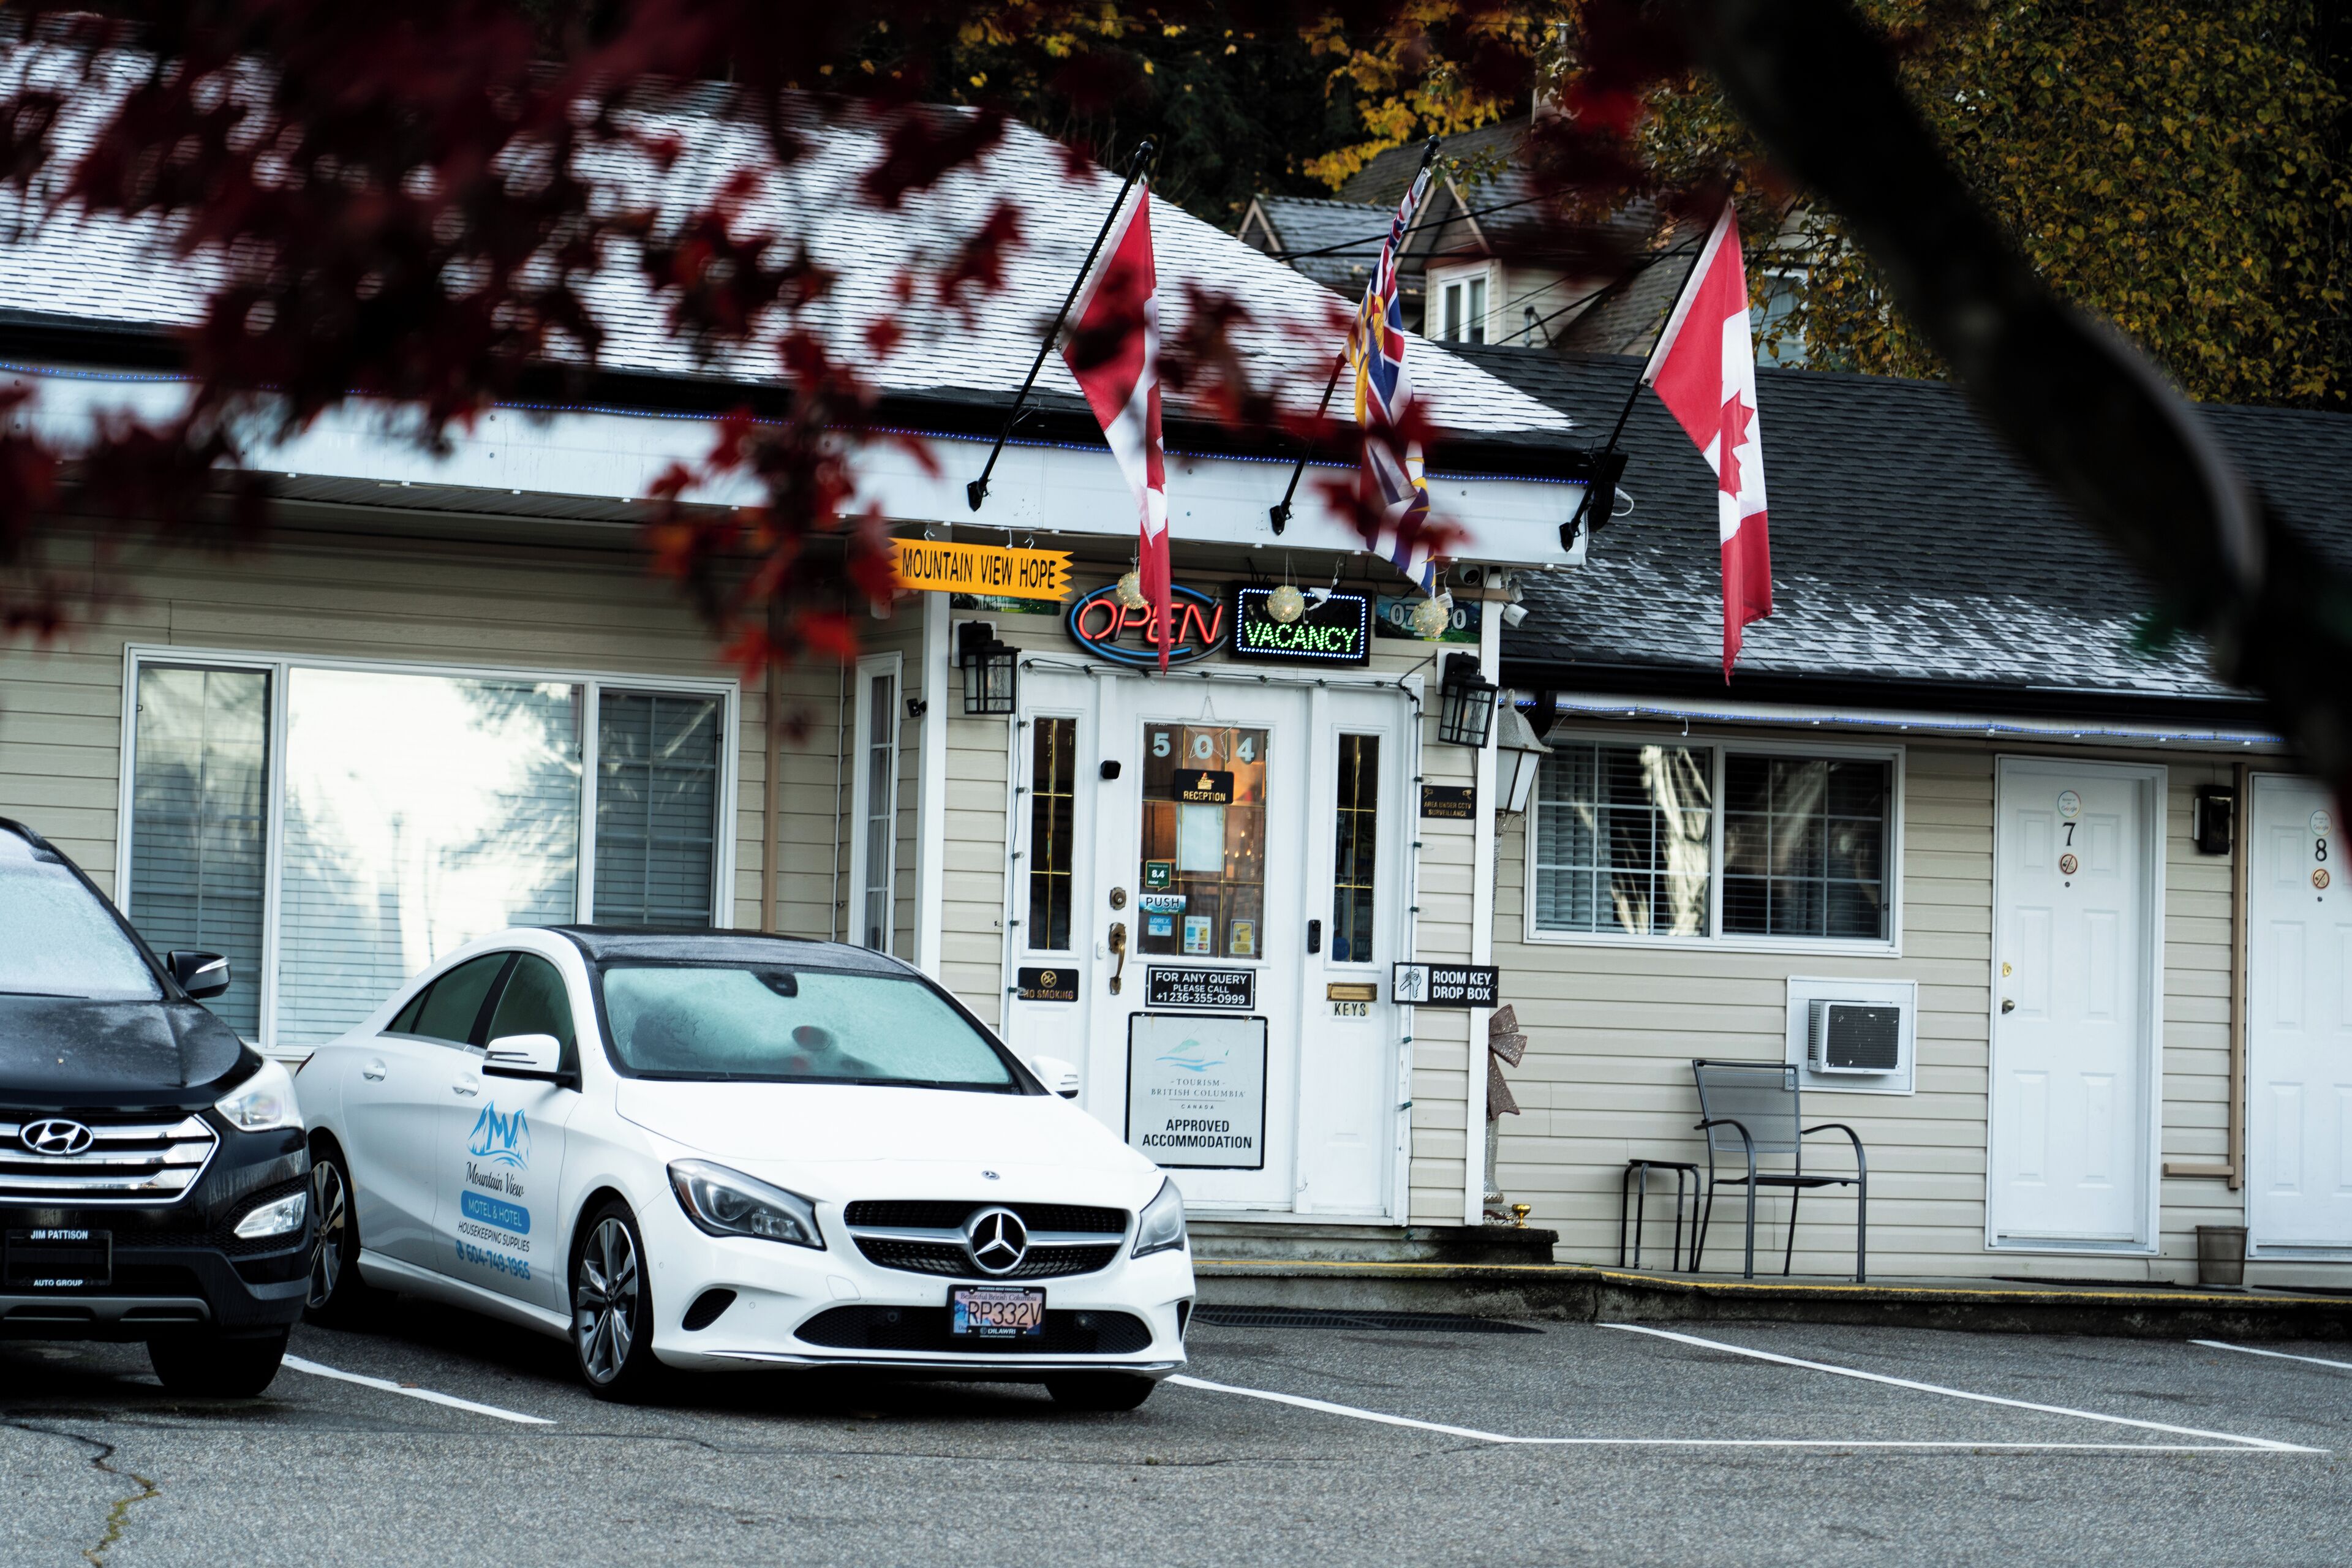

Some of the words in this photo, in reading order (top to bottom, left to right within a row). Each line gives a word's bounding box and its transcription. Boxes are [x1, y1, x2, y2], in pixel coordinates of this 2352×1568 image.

[902, 547, 973, 582] MOUNTAIN
[981, 554, 1014, 586] VIEW
[1019, 557, 1057, 590] HOPE
[1079, 598, 1223, 644] OPEN
[1245, 621, 1358, 652] VACANCY
[1183, 790, 1226, 802] RECEPTION
[1428, 809, 1467, 817] SURVEILLANCE
[2062, 822, 2076, 846] 7
[2315, 839, 2327, 862] 8
[1146, 897, 1180, 907] PUSH
[1156, 972, 1178, 982] FOR
[1182, 973, 1206, 983] ANY
[1208, 974, 1247, 985] QUERY
[1433, 971, 1467, 984] ROOM
[1469, 972, 1492, 986] KEY
[1036, 989, 1074, 1000] SMOKING
[1173, 984, 1205, 993] PLEASE
[1207, 985, 1230, 993] CALL
[1433, 986, 1464, 1000] DROP
[1467, 987, 1491, 1001] BOX
[1169, 992, 1246, 1005] 236-355-0999
[1335, 1003, 1366, 1017] KEYS
[1166, 1119, 1230, 1133] APPROVED
[1142, 1134, 1253, 1148] ACCOMMODATION
[466, 1161, 503, 1192] Mountain
[505, 1172, 524, 1197] View
[468, 1198, 491, 1218] MOTEL
[492, 1205, 497, 1219] &
[499, 1209, 522, 1227] HOTEL
[31, 1231, 45, 1239] JIM
[48, 1231, 88, 1240] PATTISON
[458, 1221, 502, 1244] HOUSEKEEPING
[502, 1232, 530, 1253] SUPPLIES
[466, 1243, 530, 1281] 604-749-1965
[968, 1301, 1041, 1325] RP332V
